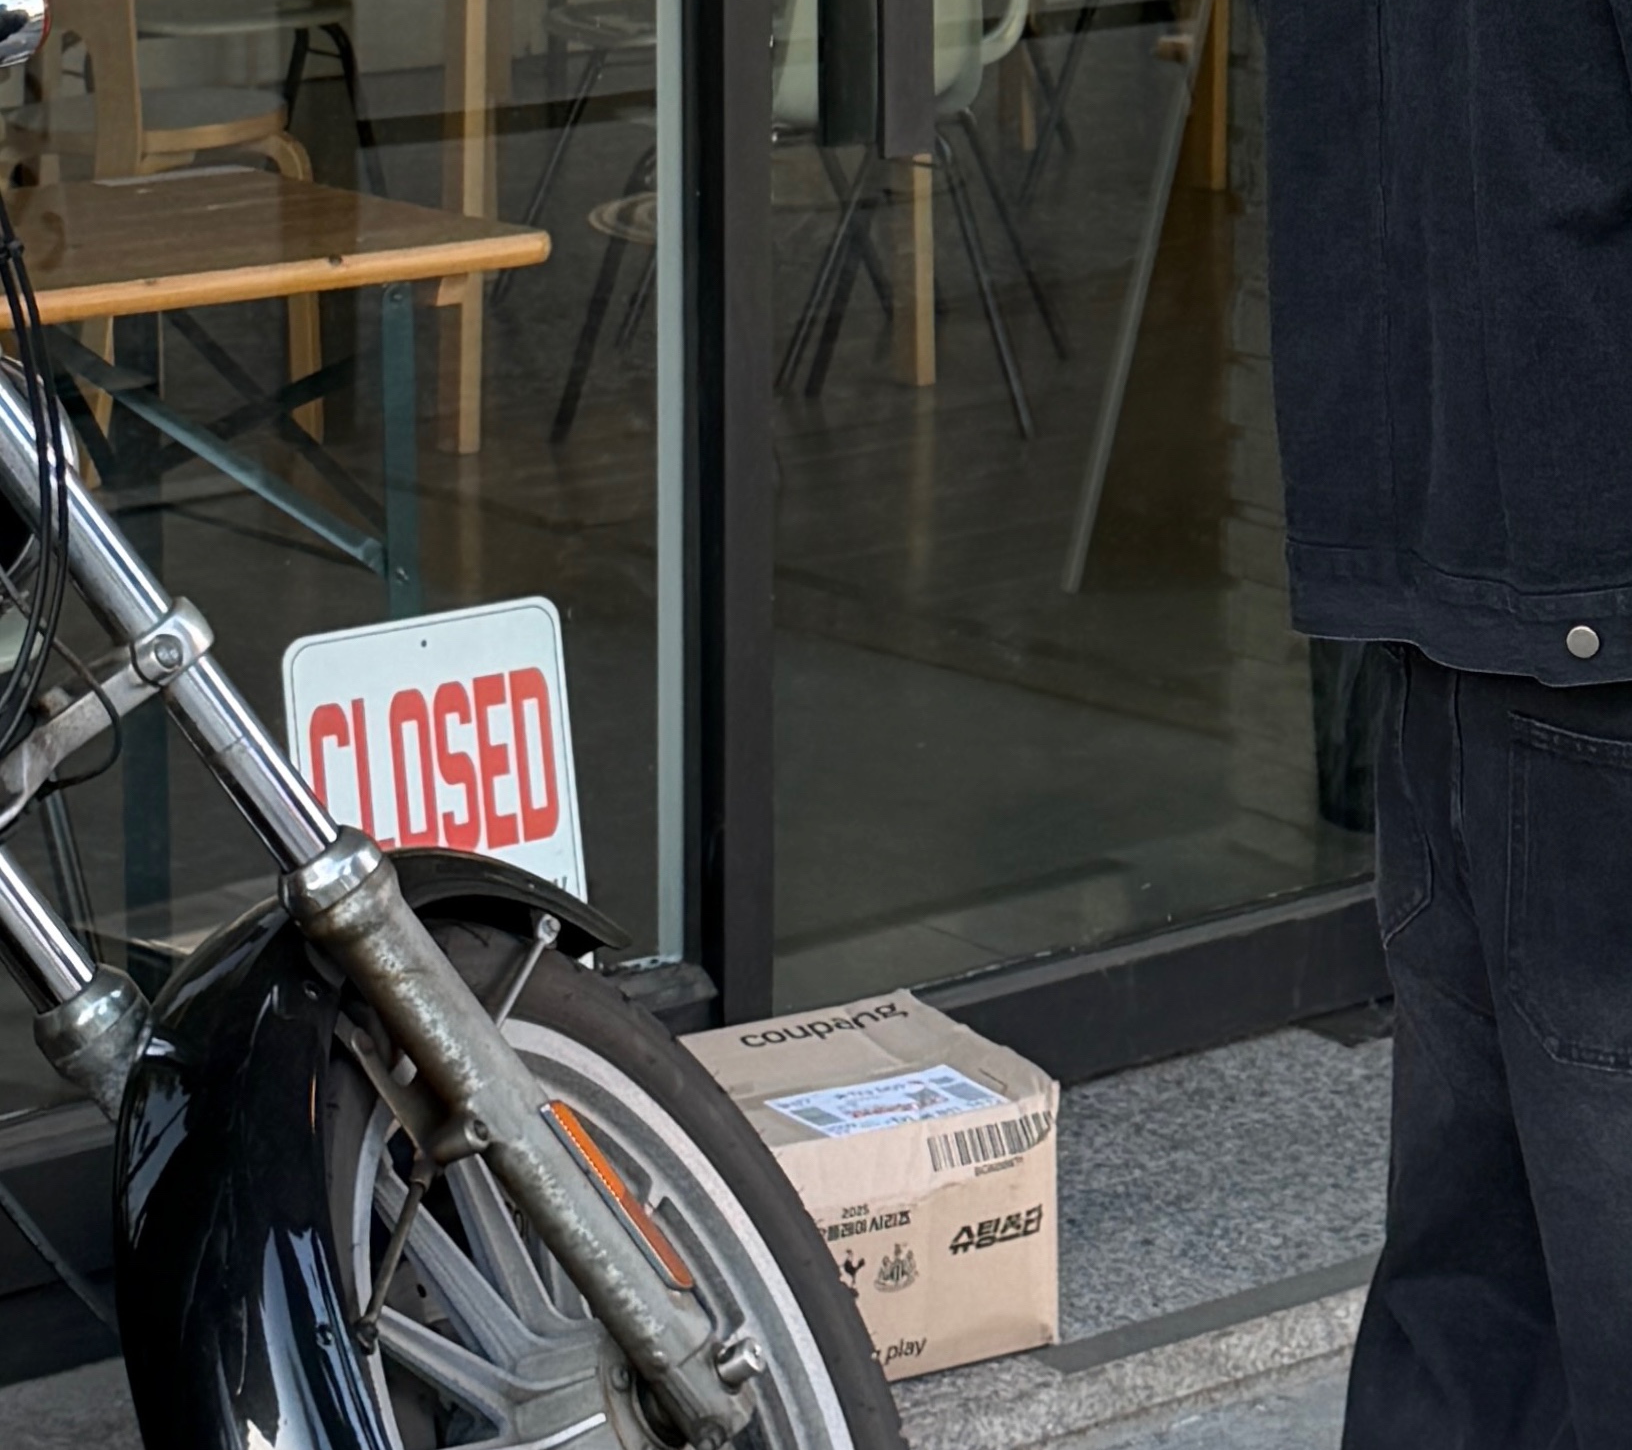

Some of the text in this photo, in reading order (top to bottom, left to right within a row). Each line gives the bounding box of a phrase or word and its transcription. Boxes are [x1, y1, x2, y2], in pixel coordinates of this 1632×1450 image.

[309, 667, 560, 852] CLOSED
[740, 1002, 909, 1048] coupang
[842, 1204, 869, 1219] 2025
[868, 1210, 910, 1232] 시리즈
[884, 1337, 927, 1365] play
